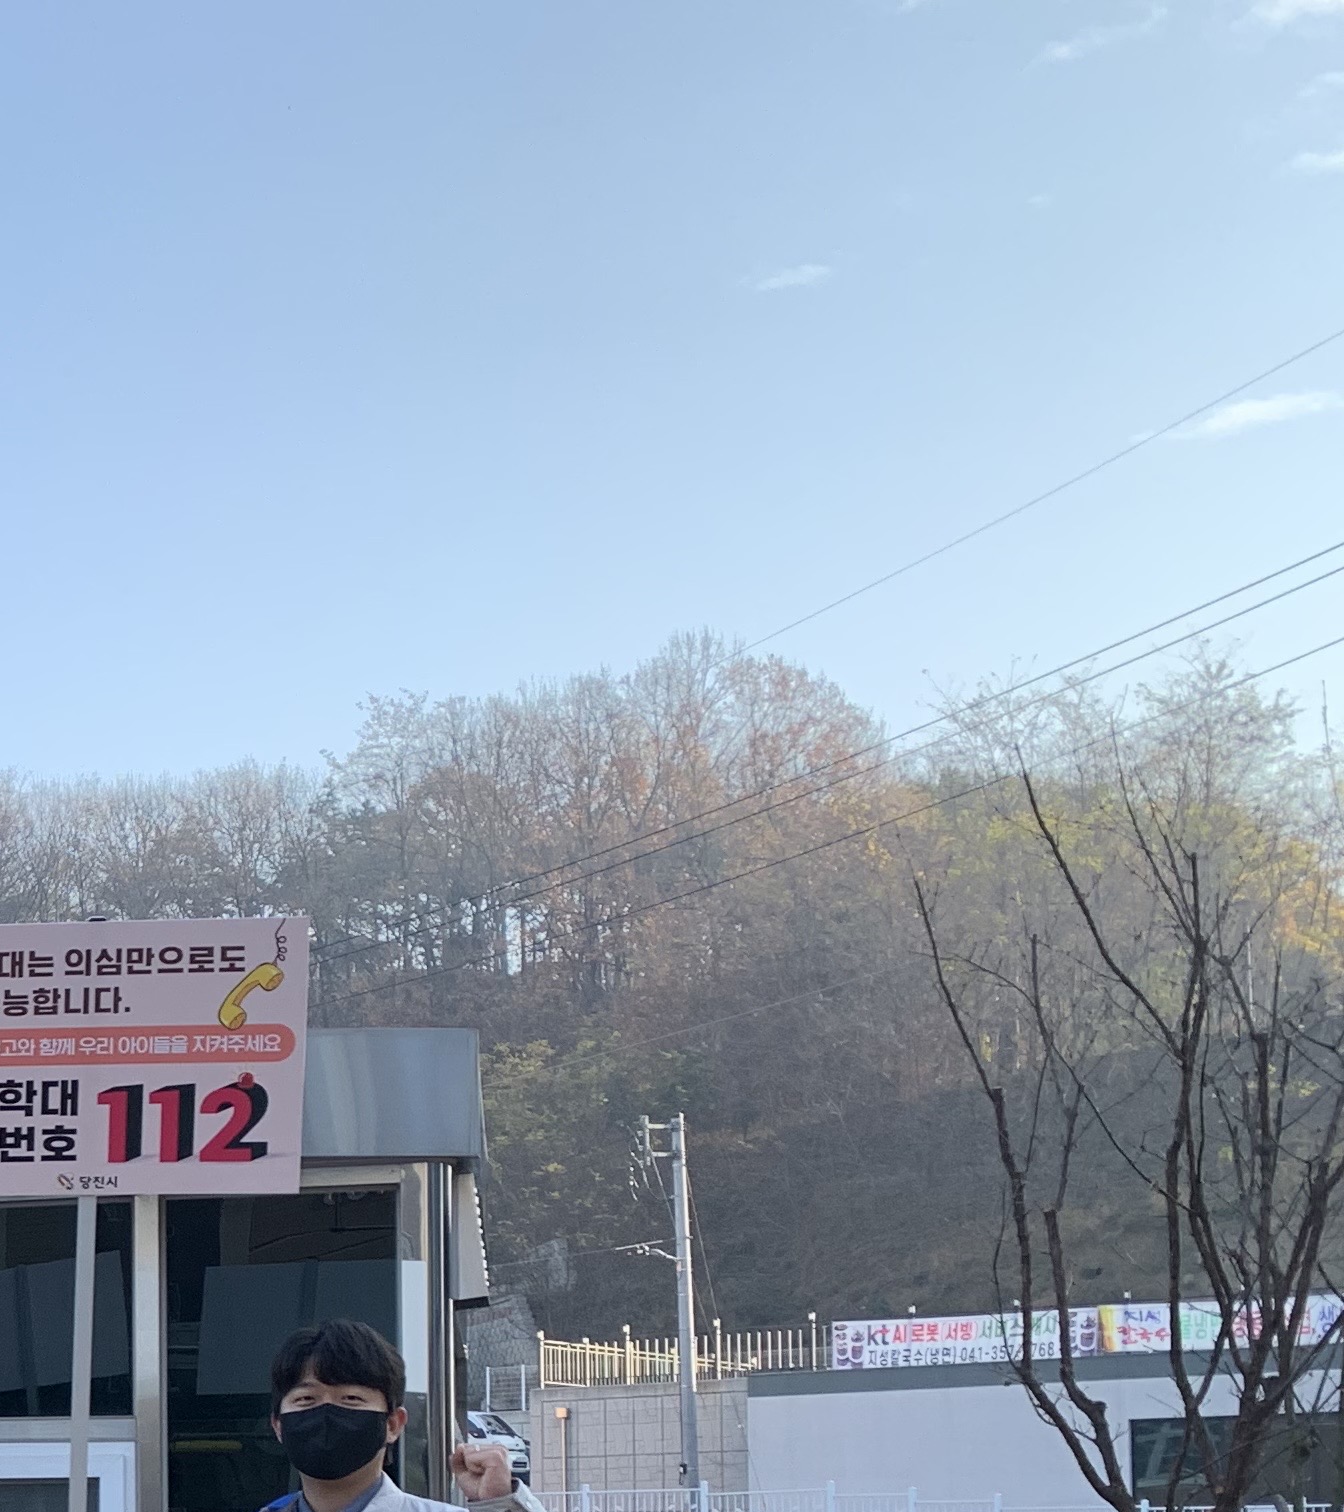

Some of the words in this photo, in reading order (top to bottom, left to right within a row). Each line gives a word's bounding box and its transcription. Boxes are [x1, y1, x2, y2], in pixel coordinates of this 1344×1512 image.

[64, 944, 246, 979] 의심만으로도
[39, 1036, 75, 1058] 함께
[78, 1036, 113, 1058] 우리
[118, 1035, 188, 1057] 아이들을
[192, 1033, 281, 1056] 지켜주세요
[97, 1081, 270, 1164] 112
[79, 1175, 119, 1189] 당진시
[867, 1323, 889, 1346] kt
[891, 1323, 907, 1343] AI
